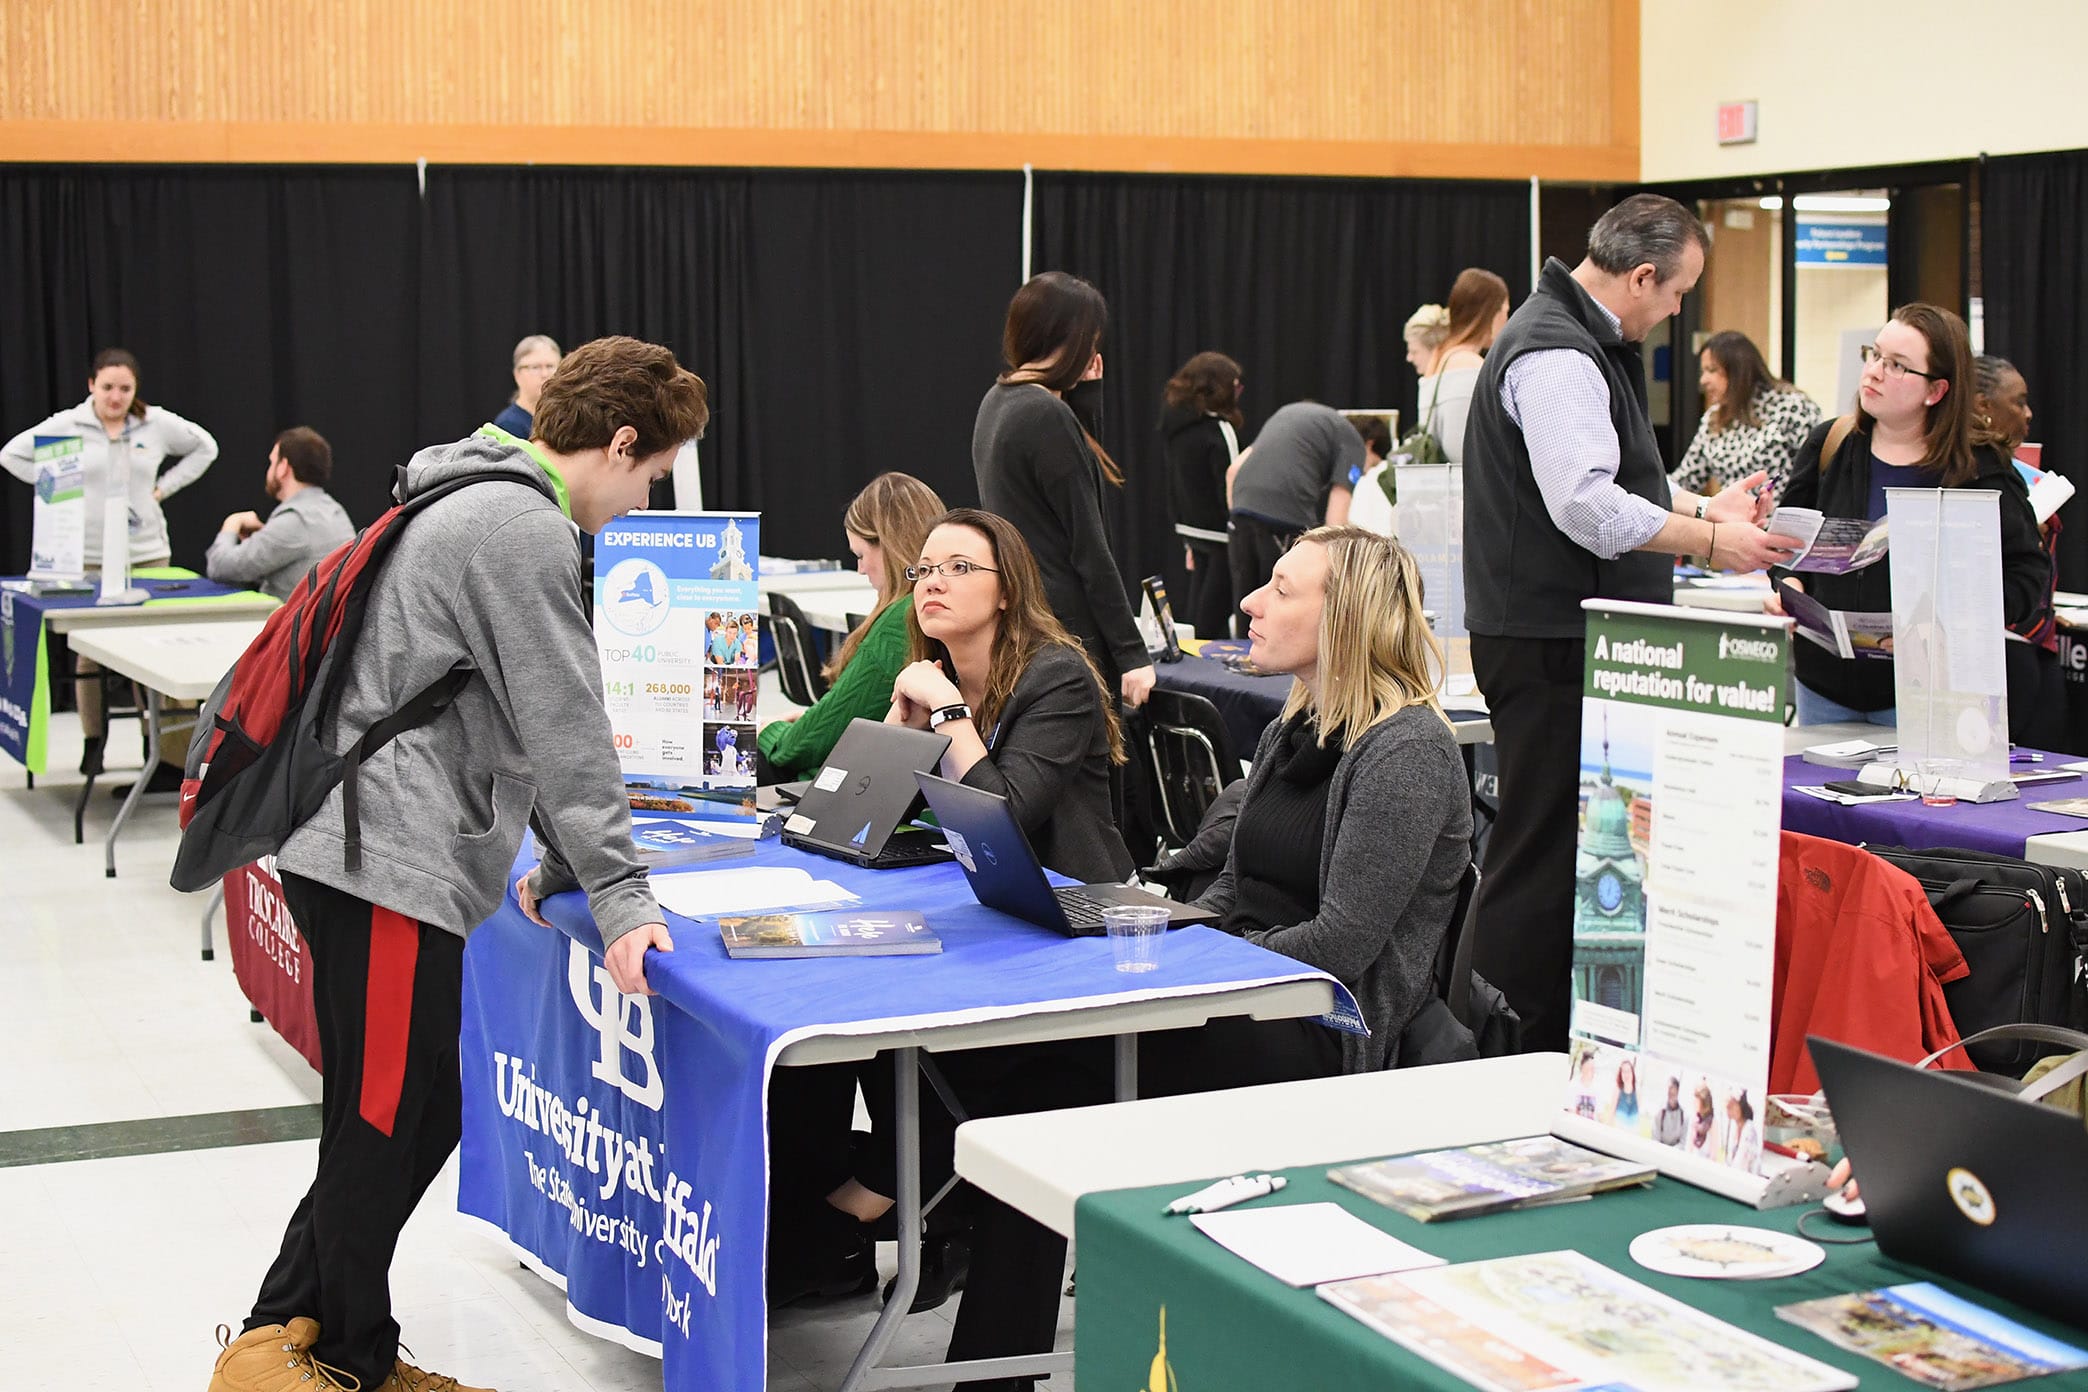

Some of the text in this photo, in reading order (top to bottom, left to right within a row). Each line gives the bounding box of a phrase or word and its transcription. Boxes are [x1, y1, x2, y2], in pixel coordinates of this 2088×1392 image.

[604, 532, 716, 548] EXPERIENCE UB
[604, 644, 656, 663] TOP 40
[1594, 634, 1683, 669] A national
[606, 682, 691, 696] 14:1 268,000
[1593, 668, 1775, 713] reputation for value!
[248, 914, 300, 984] COLLEGE
[625, 1136, 662, 1202] at
